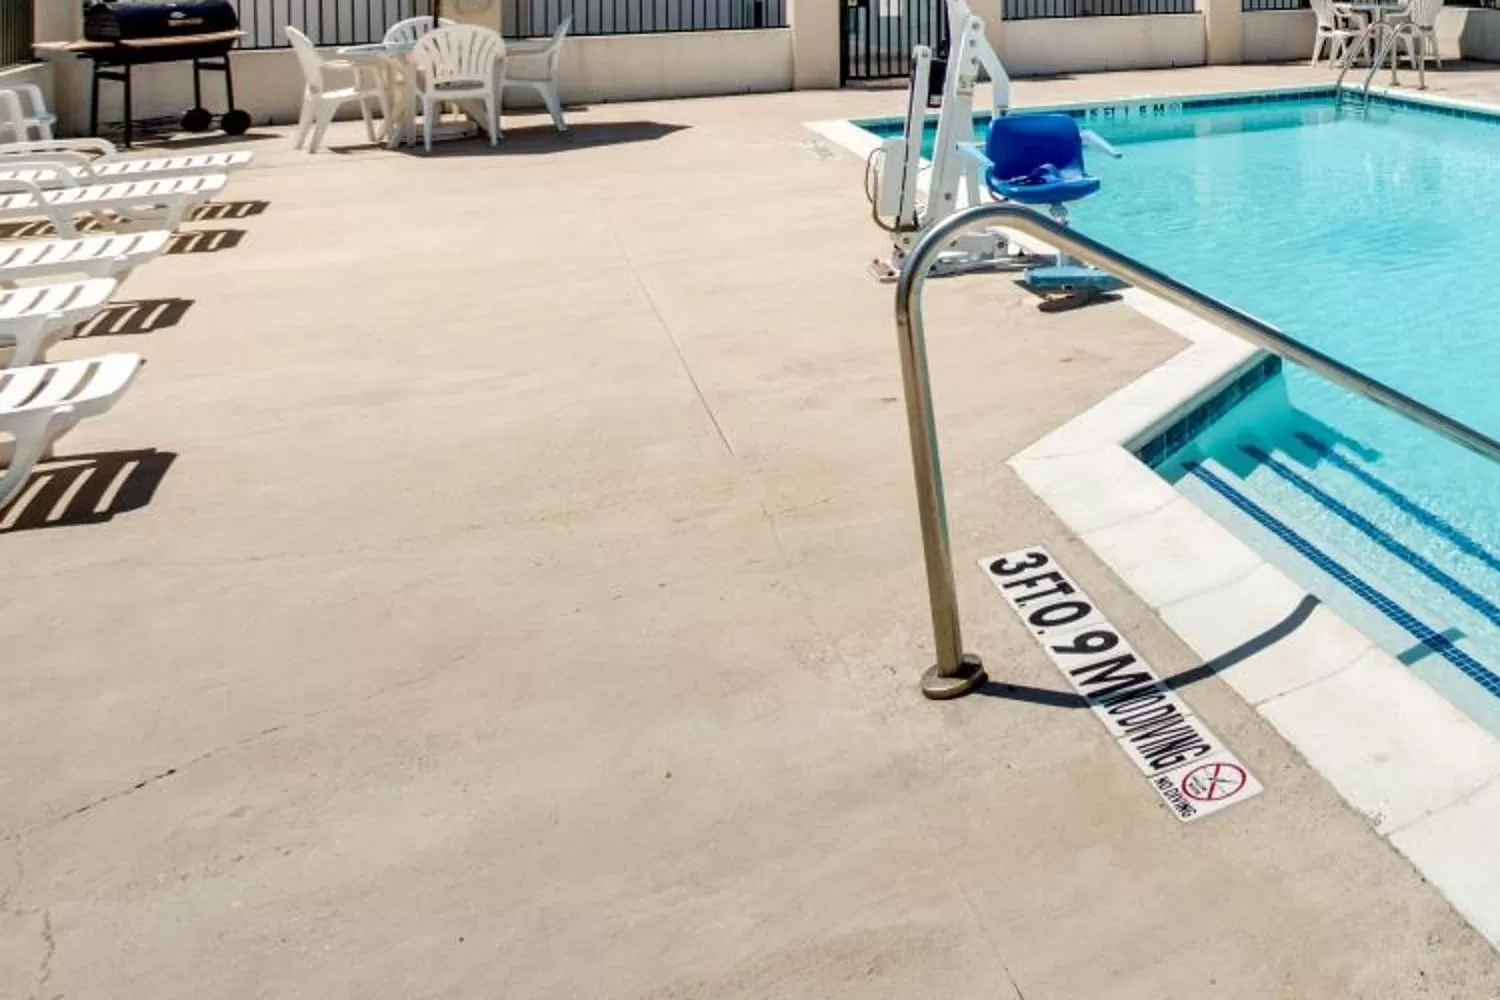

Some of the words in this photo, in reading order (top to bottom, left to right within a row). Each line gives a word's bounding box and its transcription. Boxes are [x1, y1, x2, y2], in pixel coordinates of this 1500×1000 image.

[989, 552, 1048, 576] 3
[1069, 653, 1154, 700] M
[1116, 704, 1211, 771] DIVING
[1155, 777, 1172, 792] NO
[1163, 785, 1197, 819] DIVING
